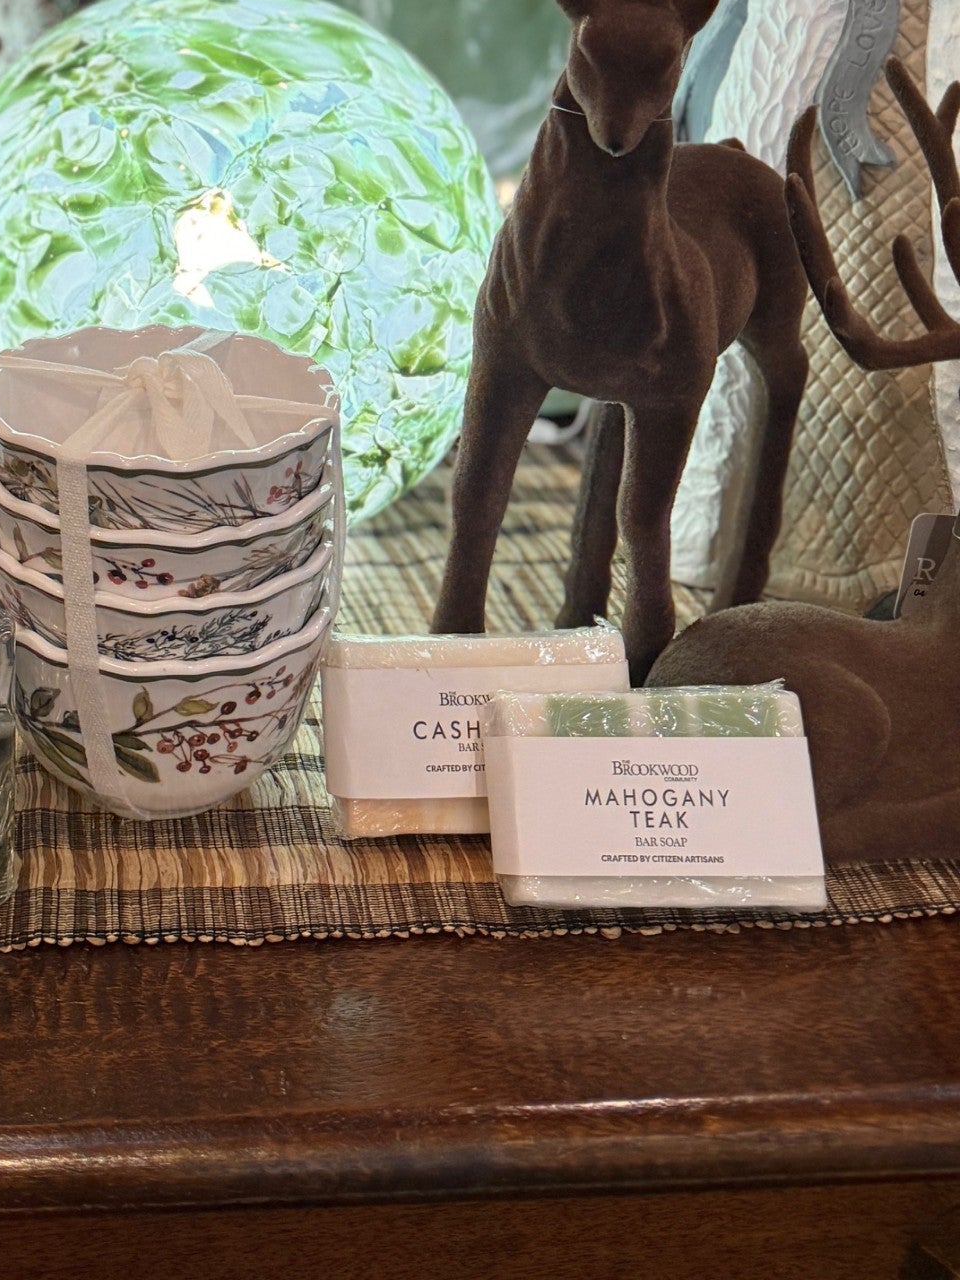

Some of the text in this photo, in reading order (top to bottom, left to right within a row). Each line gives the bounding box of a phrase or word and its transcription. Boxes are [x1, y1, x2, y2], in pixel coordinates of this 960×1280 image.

[439, 692, 492, 706] BROOKW
[413, 720, 480, 740] CASH
[458, 743, 480, 752] BAR
[425, 764, 461, 772] CRAFTED
[462, 764, 472, 772] BY
[611, 760, 699, 776] BROOKWOOD
[585, 788, 730, 807] MAHOGANY
[629, 810, 689, 828] TEAK
[635, 837, 688, 847] BAR SOAP
[601, 854, 725, 864] CRAFTED BY CITIZEN ARTISANS
